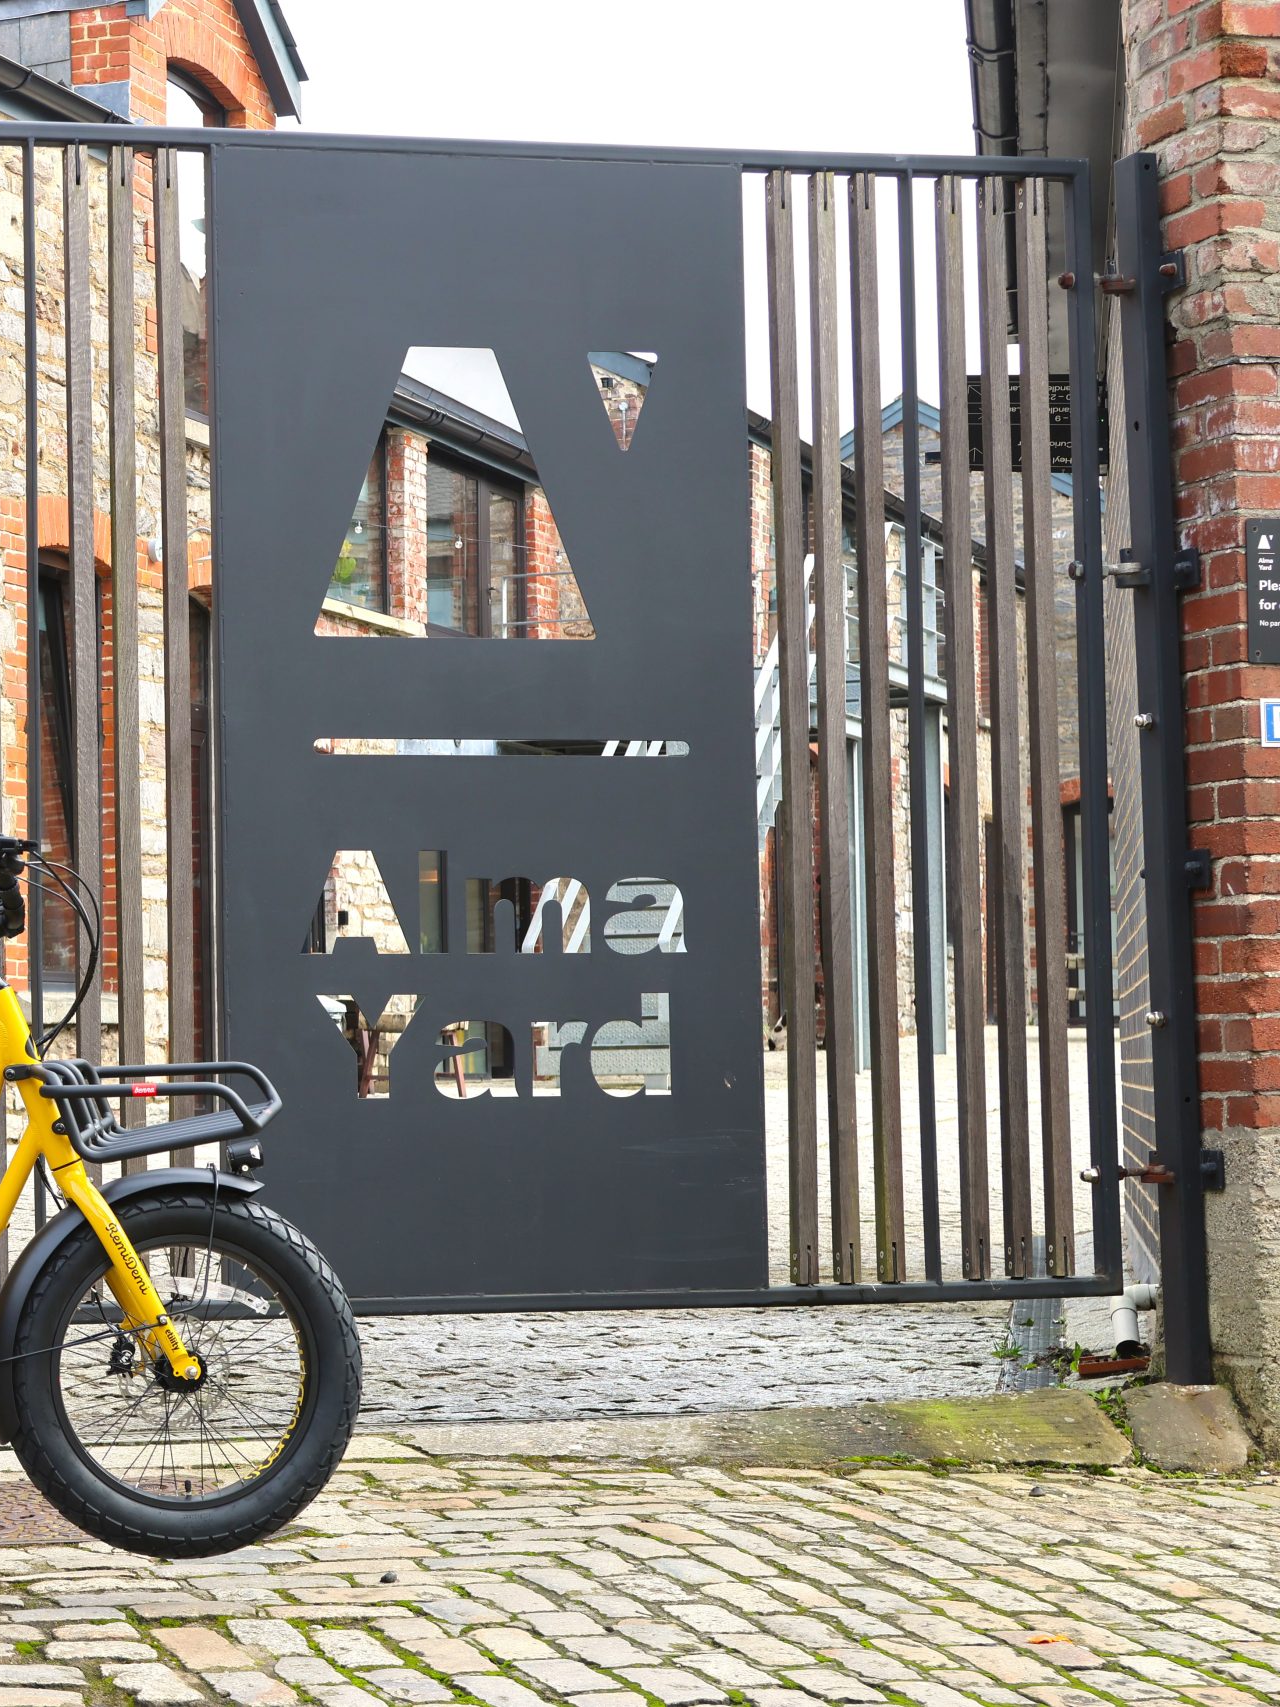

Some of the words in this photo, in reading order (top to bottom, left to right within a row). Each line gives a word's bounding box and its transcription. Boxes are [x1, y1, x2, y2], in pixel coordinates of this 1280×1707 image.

[1259, 579, 1280, 592] Ple
[1259, 598, 1277, 610] for
[1259, 619, 1269, 627] No
[300, 850, 688, 955] Alma
[315, 992, 672, 1099] Yard
[104, 1221, 152, 1297] RemiDemi
[164, 1328, 182, 1351] etility
